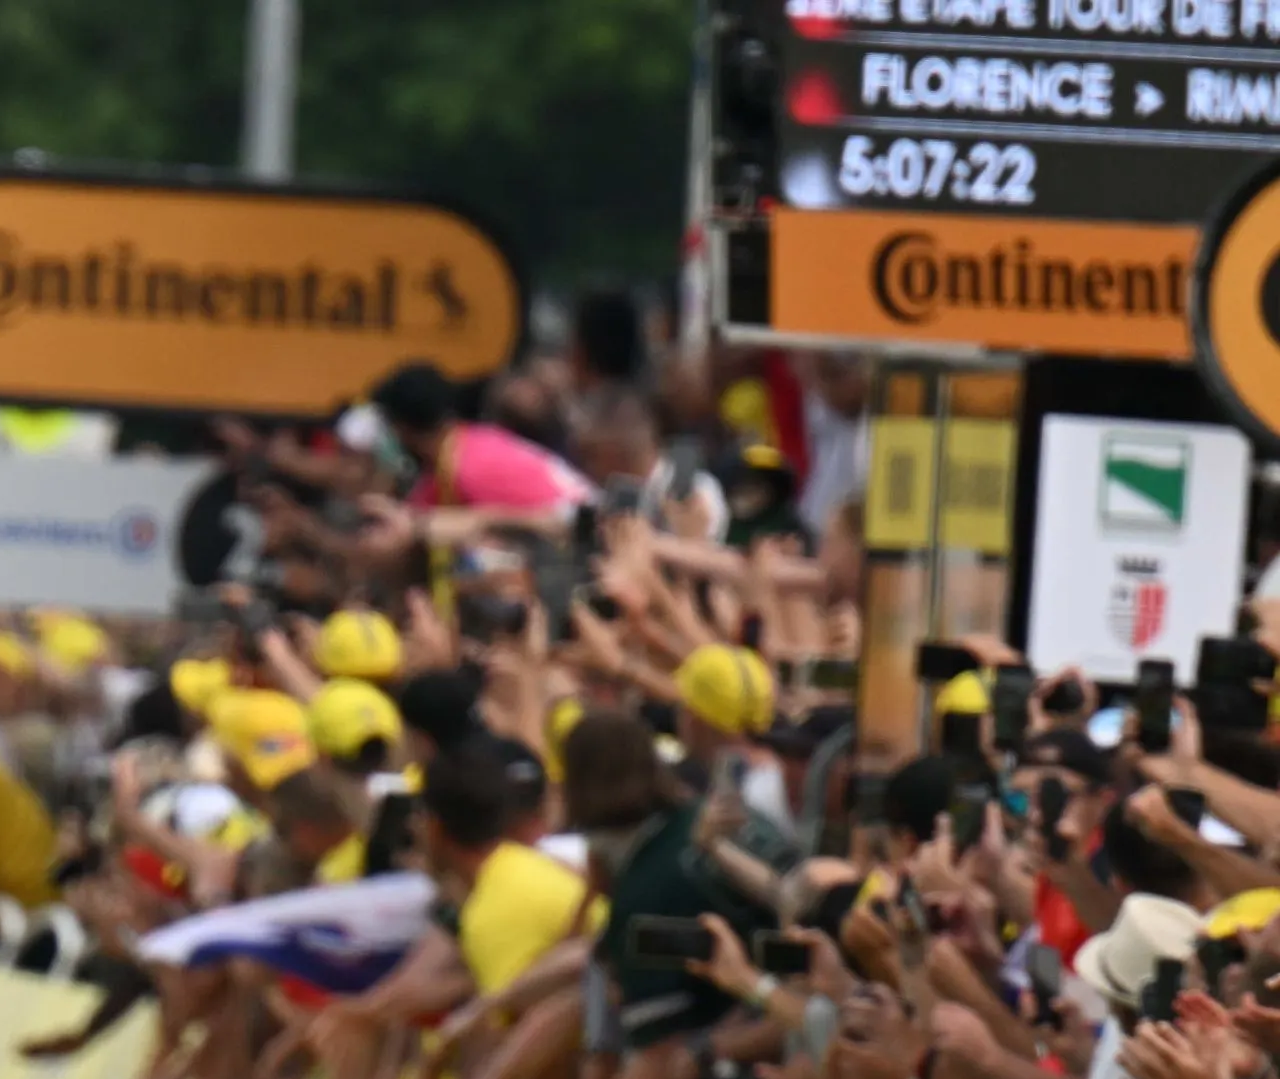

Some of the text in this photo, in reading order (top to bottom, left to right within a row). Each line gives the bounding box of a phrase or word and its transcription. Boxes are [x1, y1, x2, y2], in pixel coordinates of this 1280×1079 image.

[862, 53, 1114, 119] FLORENCE
[840, 136, 1037, 205] 5:07:22
[870, 230, 1186, 325] Continent
